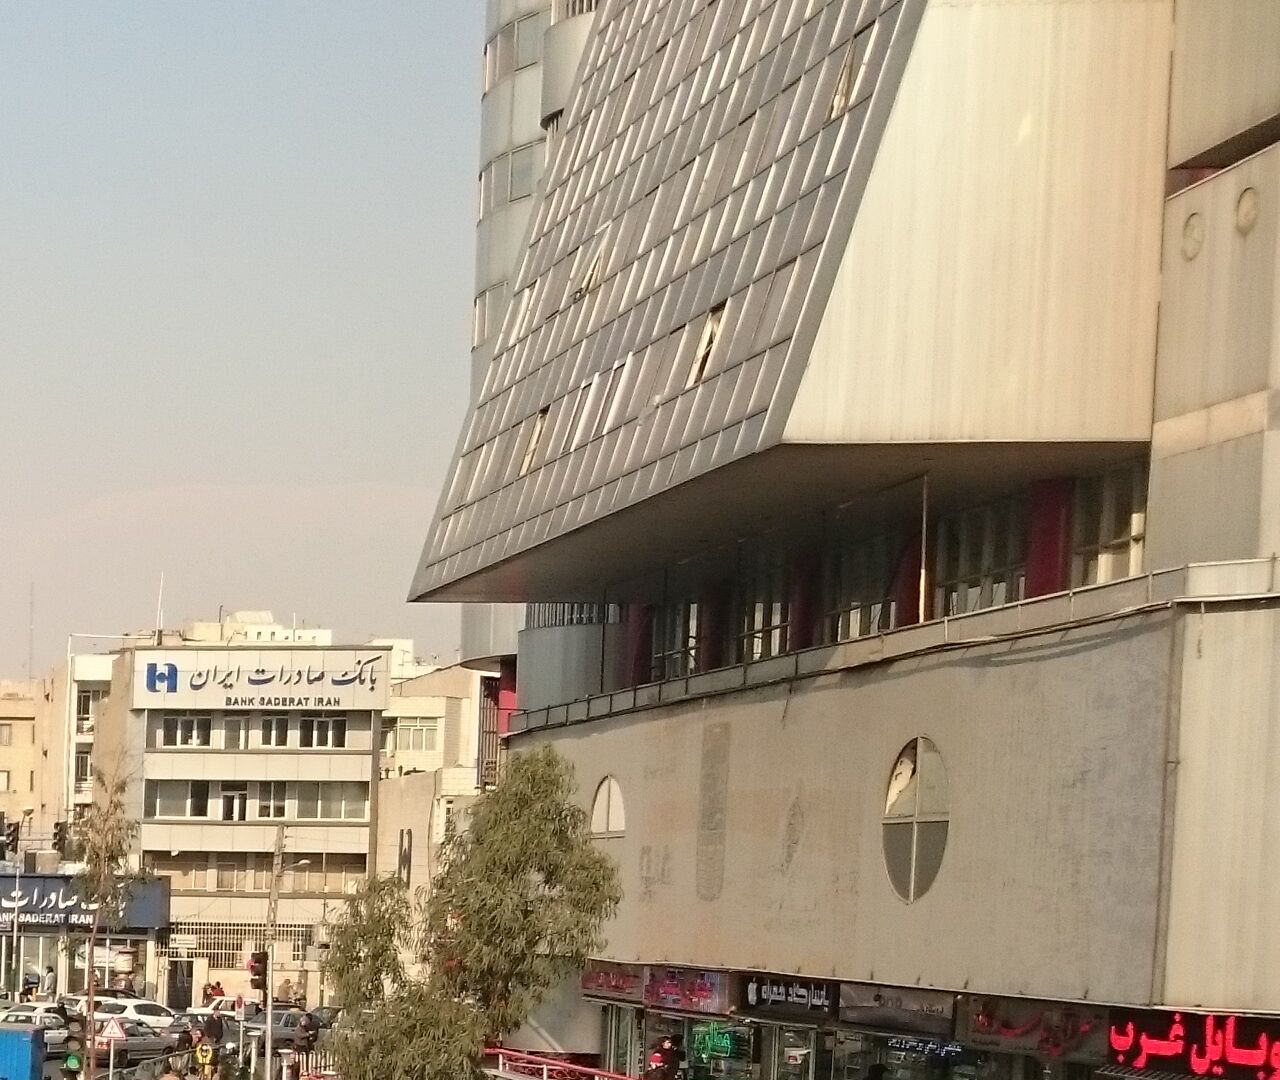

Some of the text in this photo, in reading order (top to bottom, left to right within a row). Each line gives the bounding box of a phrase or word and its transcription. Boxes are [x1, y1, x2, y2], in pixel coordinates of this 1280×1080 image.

[189, 655, 382, 691] بانک صادرات ایران
[225, 696, 340, 707] BANK SADERAT IRAN
[1, 886, 78, 909] صادرات
[18, 912, 67, 924] SADERAT
[68, 913, 94, 924] IRAN
[1109, 1012, 1185, 1070] غرب
